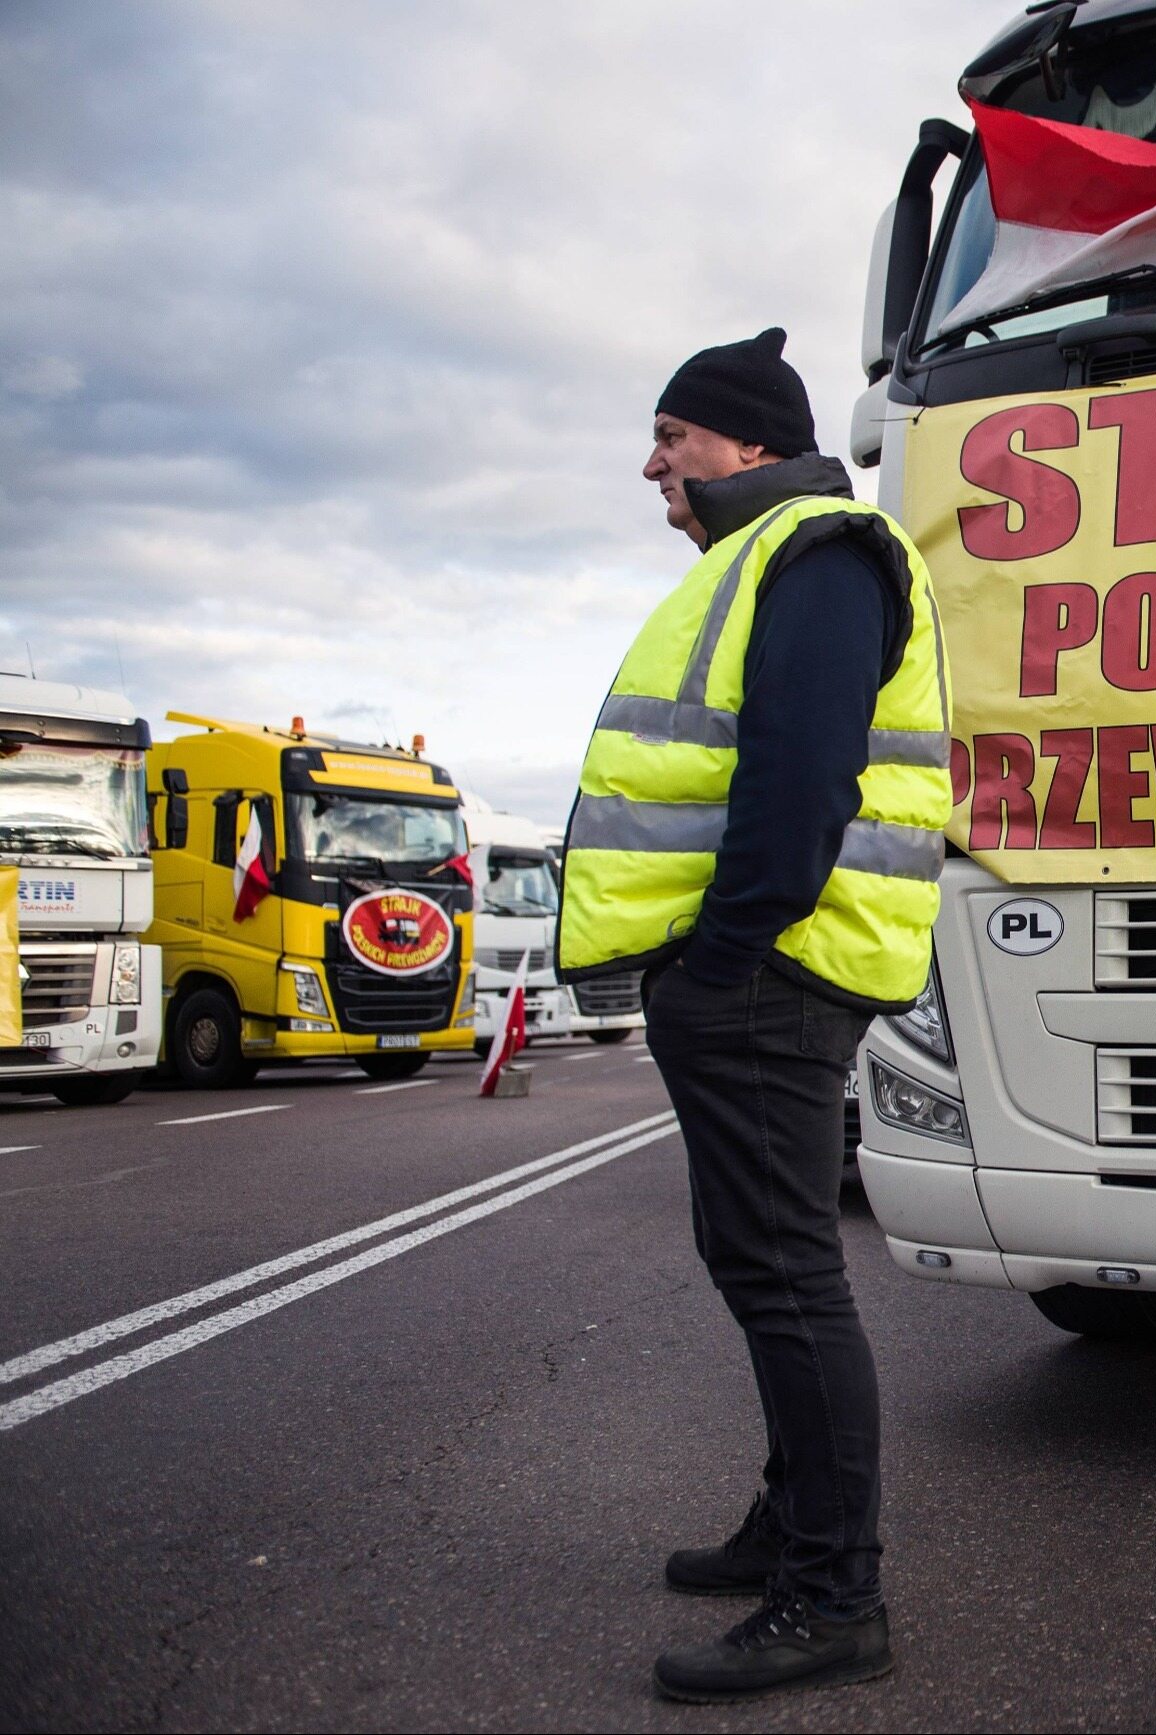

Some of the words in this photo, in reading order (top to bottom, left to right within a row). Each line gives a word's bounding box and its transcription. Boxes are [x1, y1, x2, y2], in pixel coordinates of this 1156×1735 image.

[381, 895, 422, 917] STRAJK
[1002, 913, 1052, 939] PL
[86, 1023, 101, 1034] PL
[21, 1034, 47, 1047] 130
